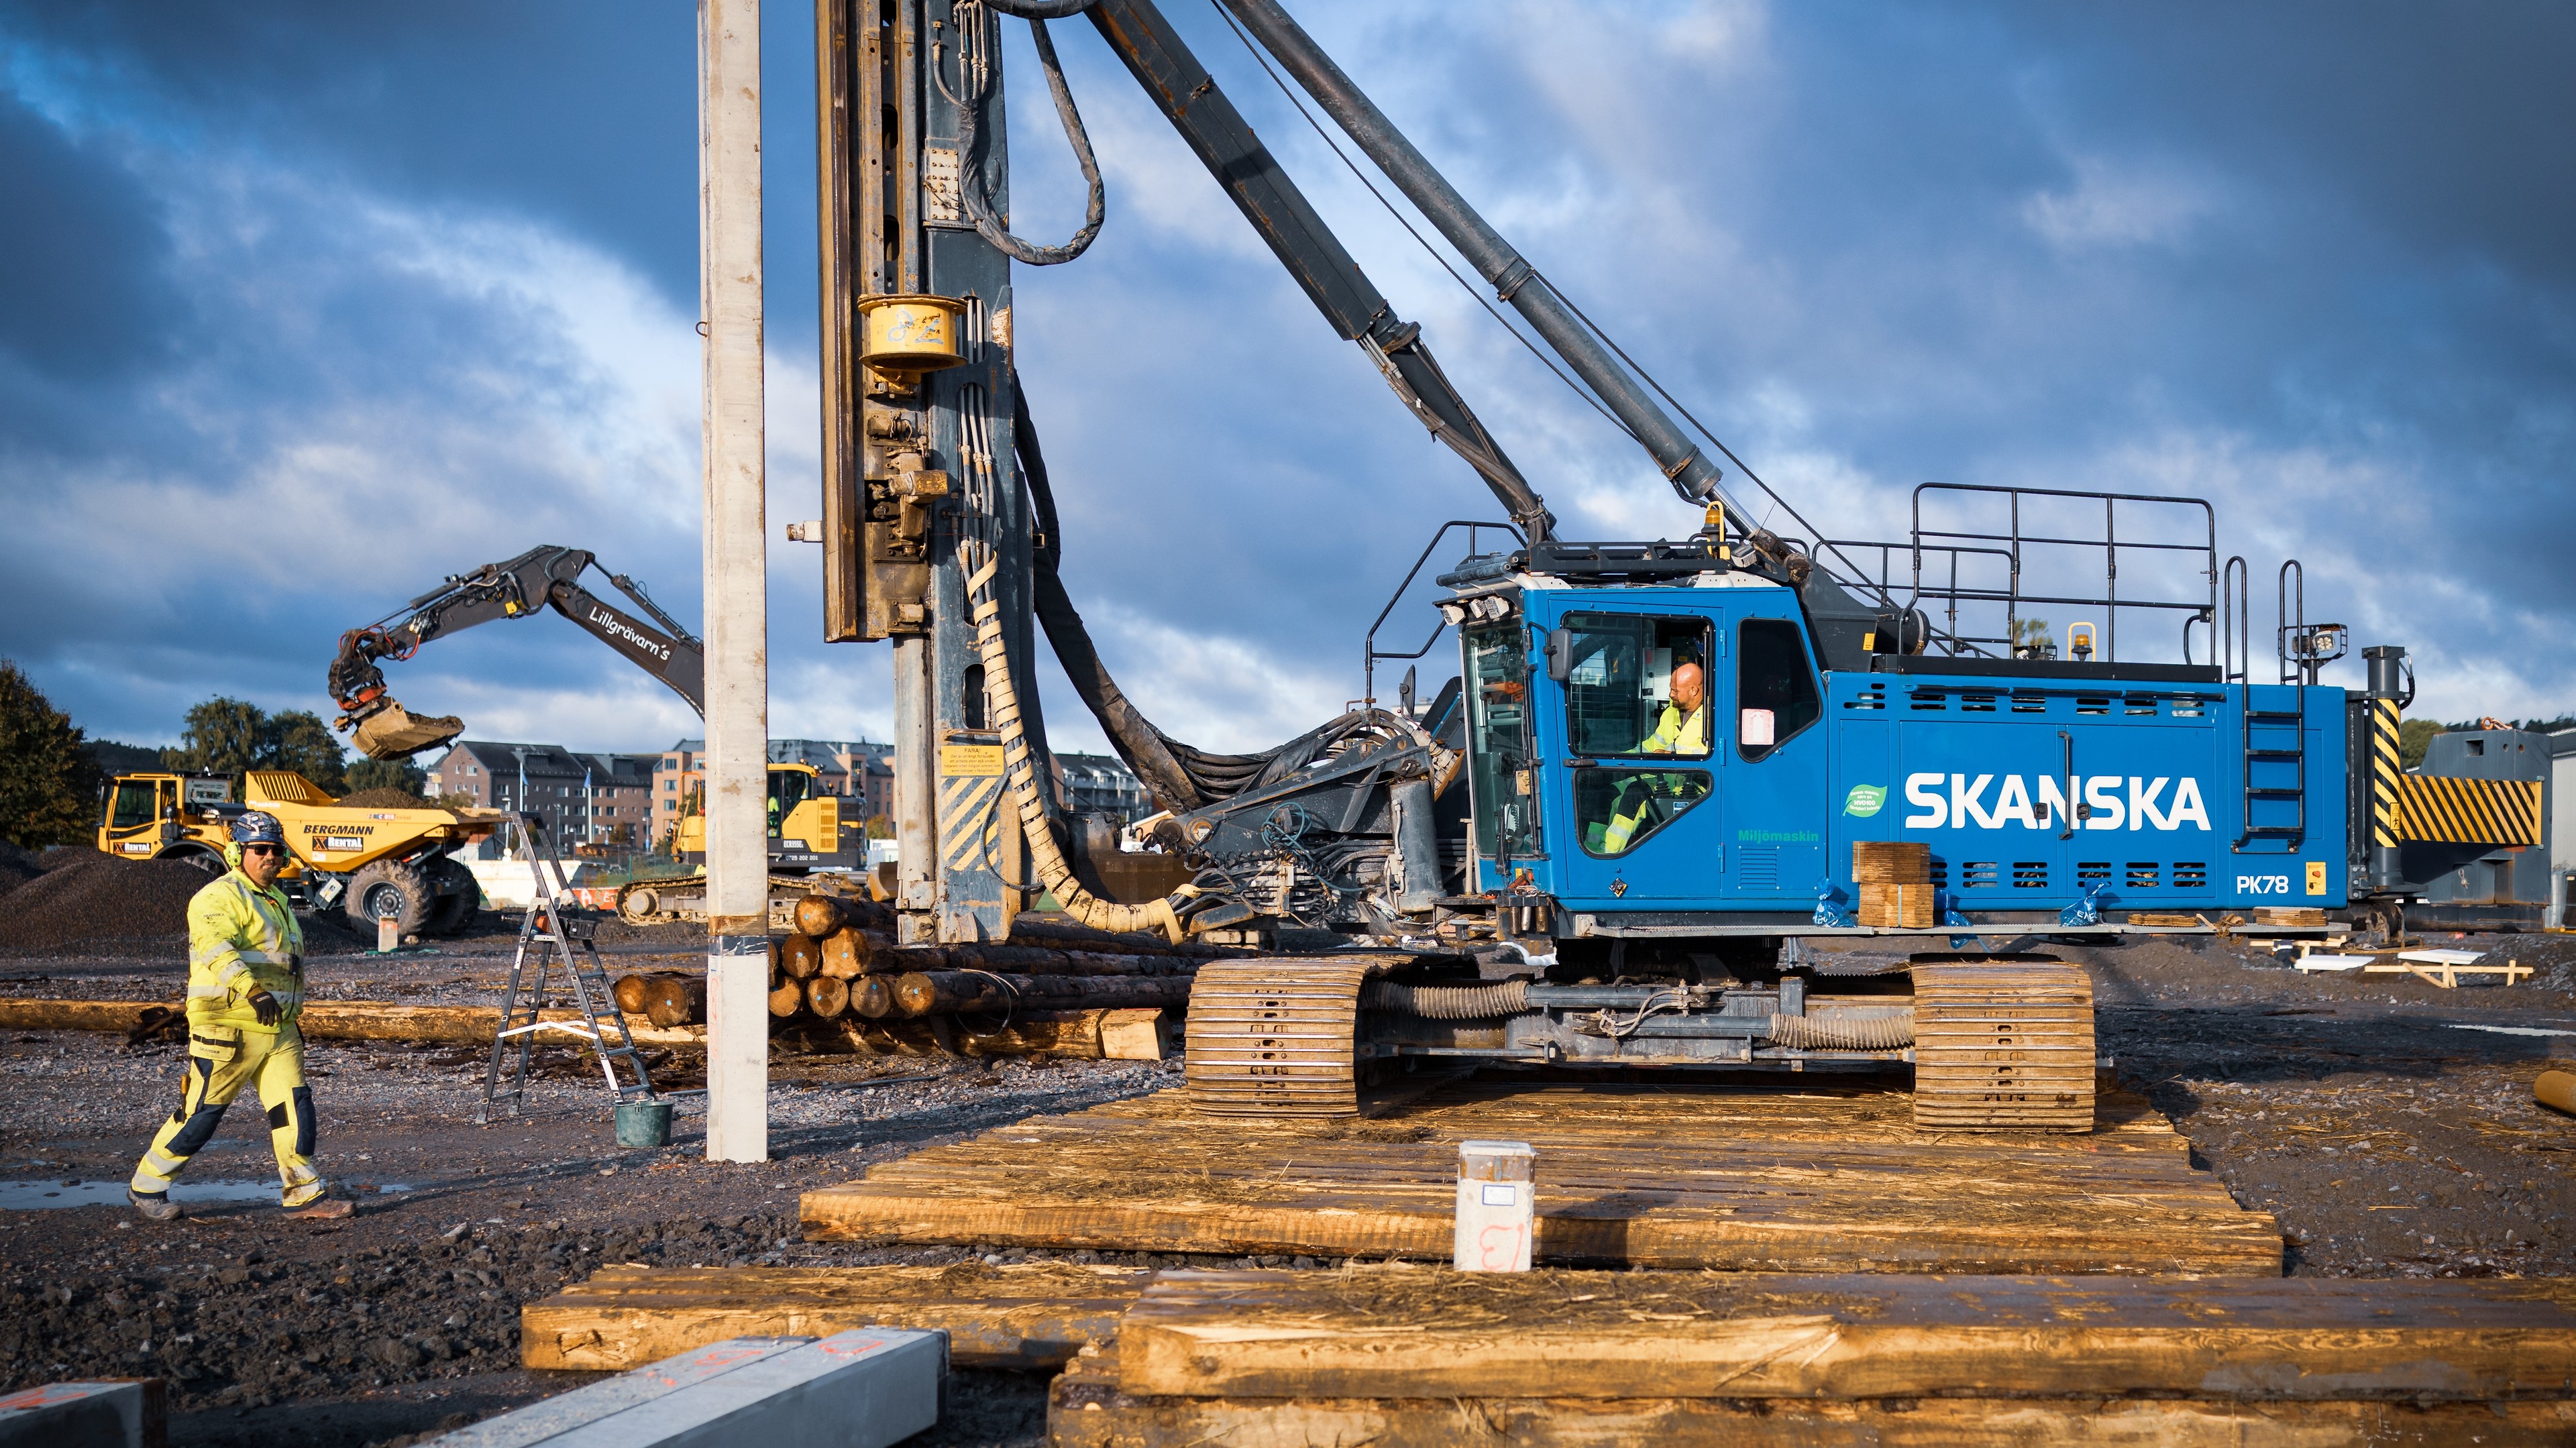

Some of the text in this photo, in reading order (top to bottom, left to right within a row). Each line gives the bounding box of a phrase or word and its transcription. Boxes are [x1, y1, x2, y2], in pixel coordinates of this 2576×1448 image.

[1905, 773, 2212, 831] SKANSKA
[303, 824, 374, 835] BERGMANN
[327, 836, 363, 848] RENTAL
[1738, 829, 1819, 844] Miljömaskin
[125, 842, 151, 852] RENTAL
[2237, 875, 2289, 894] PK78
